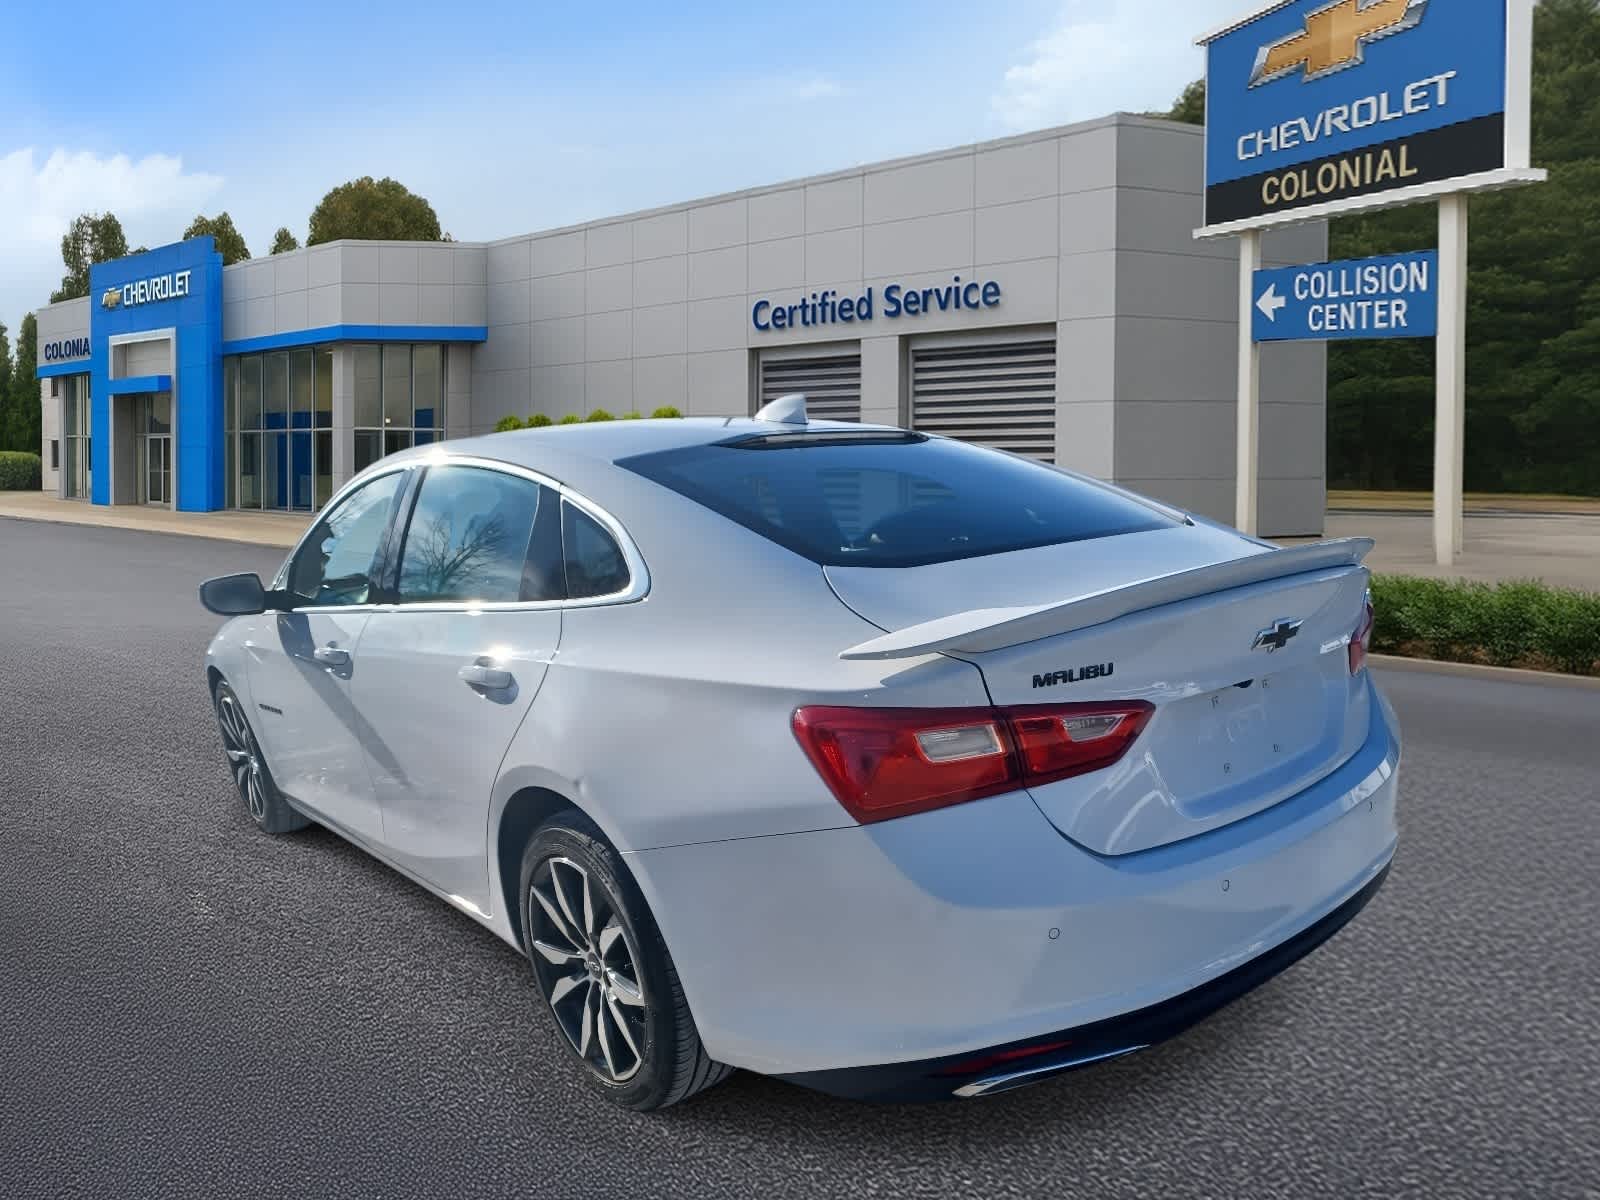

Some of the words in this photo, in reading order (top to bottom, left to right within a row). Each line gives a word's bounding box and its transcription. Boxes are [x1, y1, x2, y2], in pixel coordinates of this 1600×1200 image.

[1237, 70, 1456, 160] CHEVROLET
[1261, 145, 1418, 205] COLONIAL
[123, 270, 191, 305] CHEVROLET
[1294, 261, 1428, 300] COLLISION
[752, 287, 873, 330] Certified
[883, 275, 1001, 318] Service
[1308, 299, 1408, 331] CENTER
[44, 337, 91, 361] COLONIA
[1032, 662, 1114, 688] MALIBU
